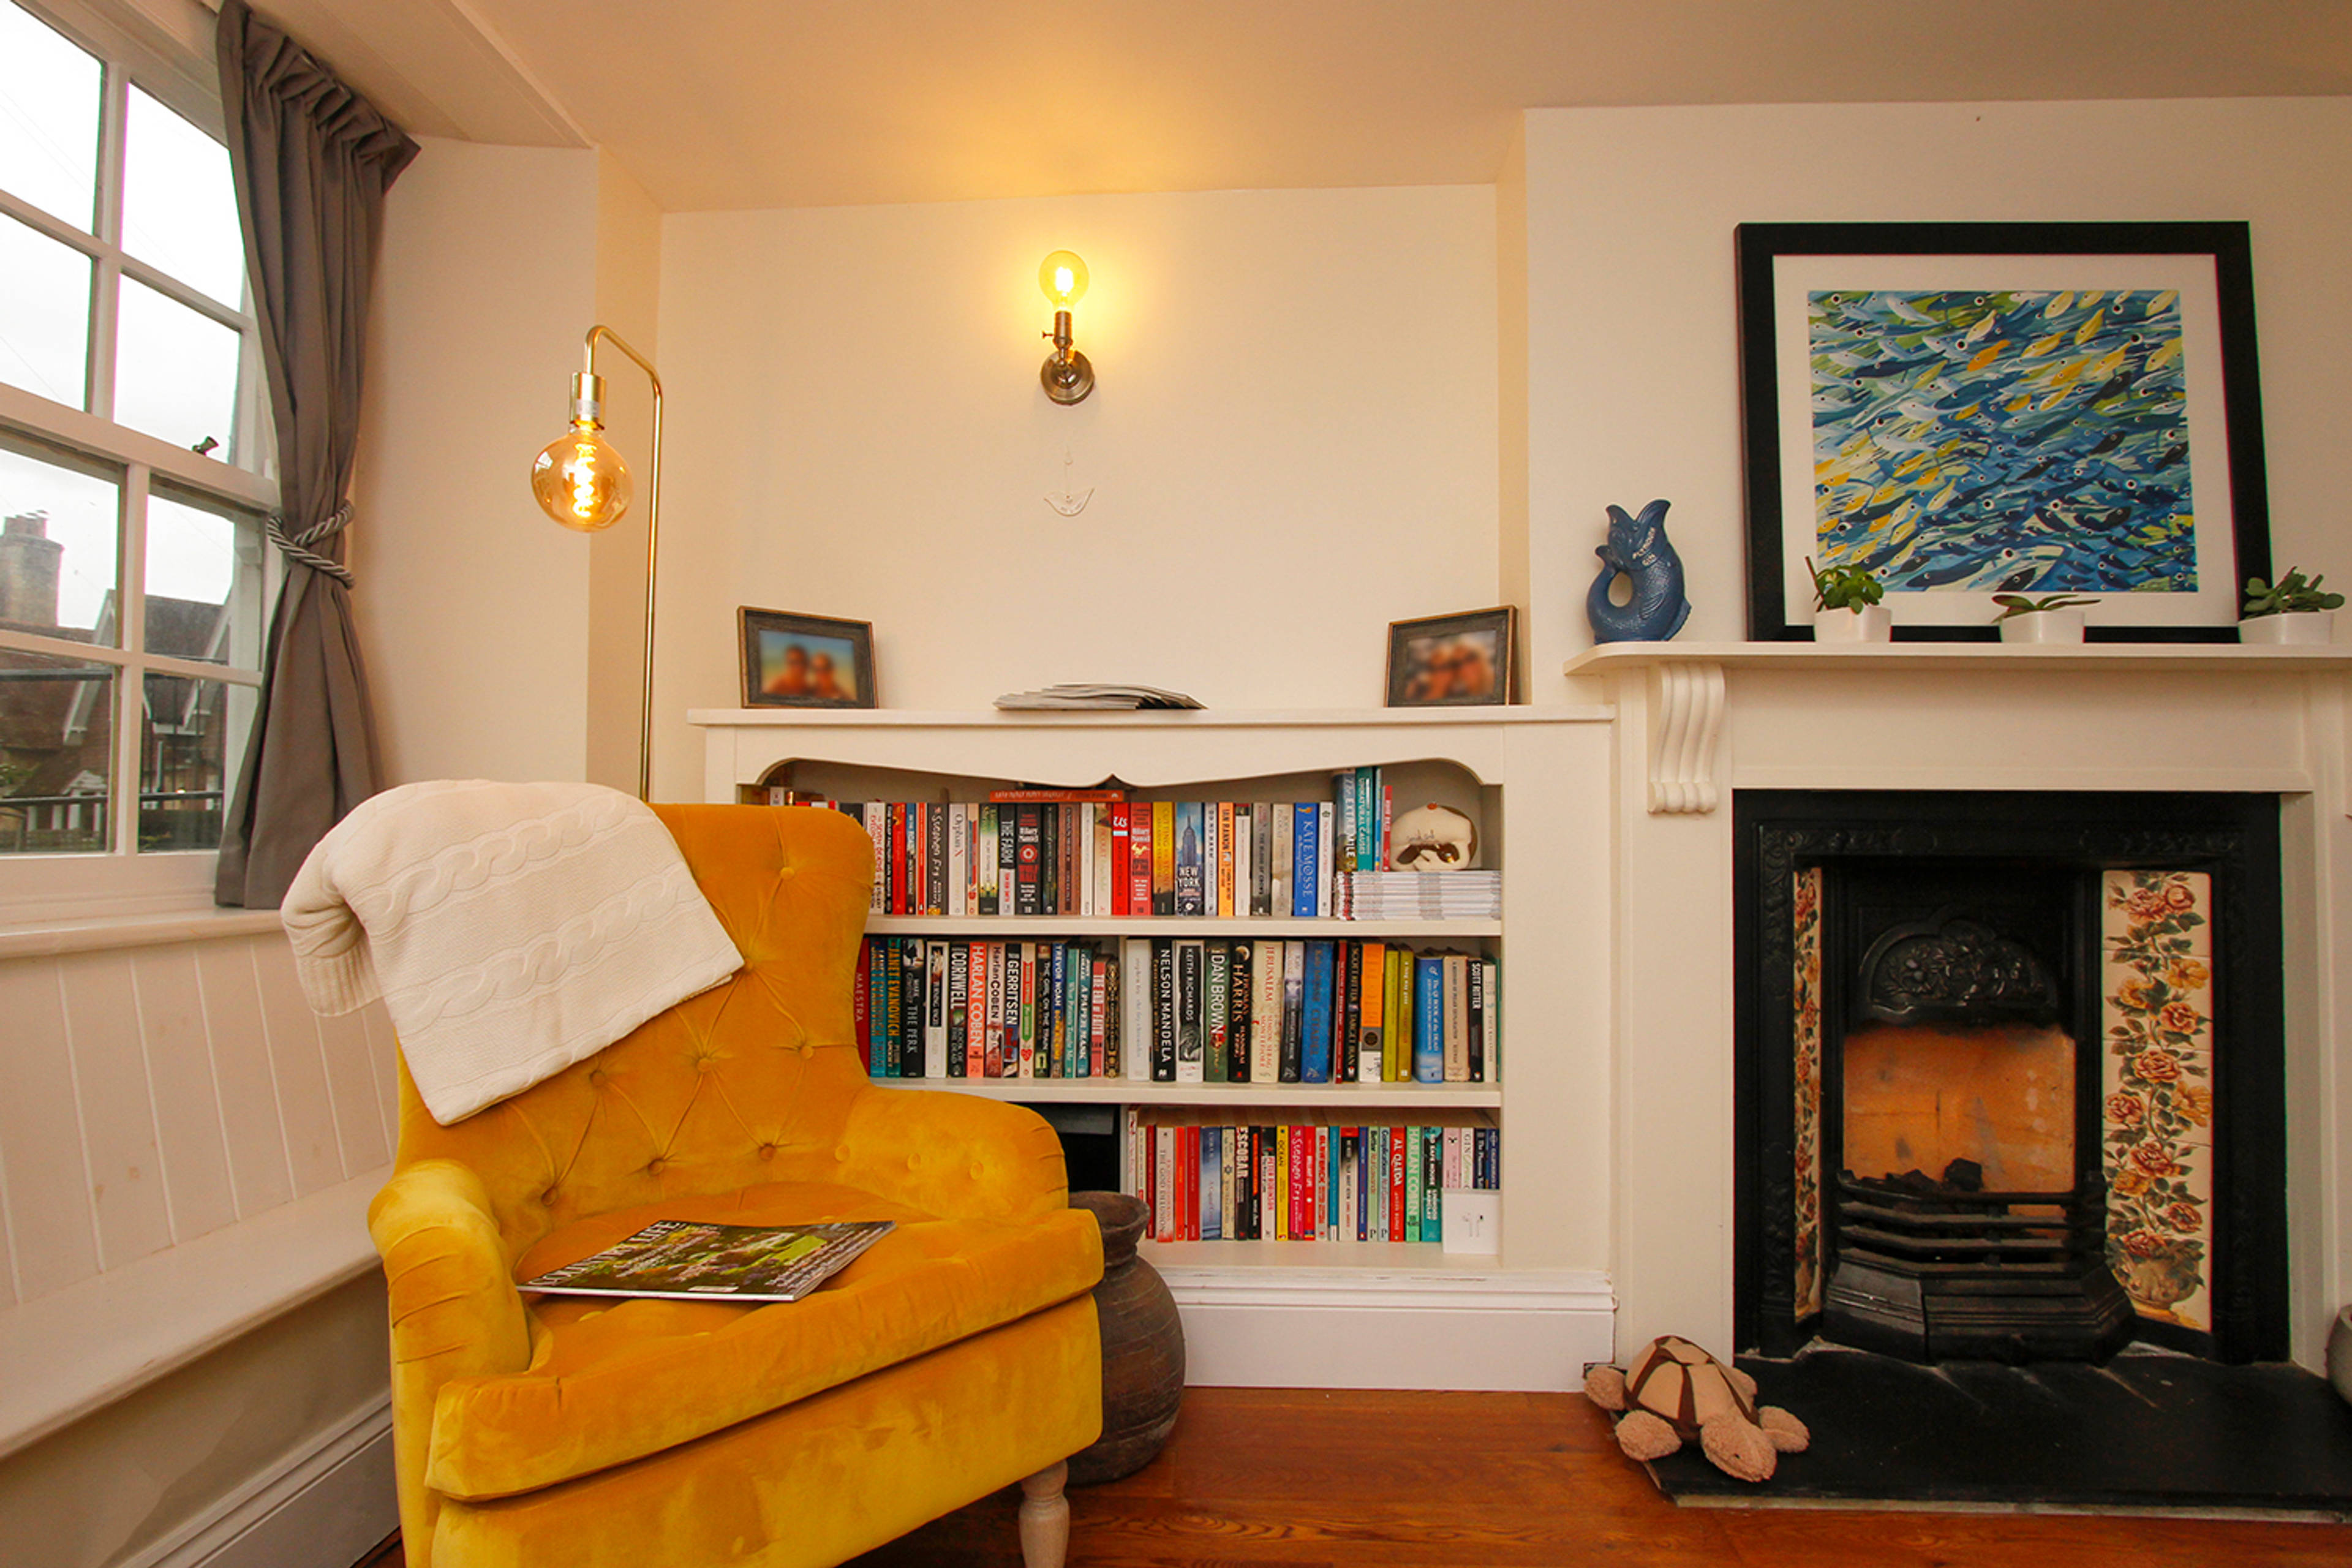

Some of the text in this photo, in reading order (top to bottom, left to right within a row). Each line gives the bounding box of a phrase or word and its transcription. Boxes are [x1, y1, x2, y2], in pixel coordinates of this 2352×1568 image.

[952, 813, 964, 848] Orphan
[1001, 820, 1014, 864] THE FARM
[1221, 823, 1230, 850] RANKIN
[932, 859, 941, 877] Fry
[1178, 866, 1199, 876] NEW
[1302, 821, 1314, 897] KATE MOSSE
[951, 953, 966, 1009] CORNWELL
[992, 946, 1001, 979] Harlan
[1210, 954, 1225, 982] DAN
[1265, 946, 1275, 1002] JERUSALEM
[1351, 948, 1360, 974] SCOTT
[871, 947, 884, 1036] JANET EVANOVICH
[888, 948, 900, 1036] JANET EVANOVICH
[970, 945, 984, 1047] HARLAN COBEN
[991, 979, 1001, 1019] COBEN
[1006, 960, 1019, 1025] GERRITSEN
[1043, 999, 1050, 1010] ON
[1093, 974, 1104, 1036] THE END FAITH
[1161, 949, 1172, 1063] NELSON MANDELA
[1210, 984, 1225, 1034] BROWN
[1232, 964, 1245, 1022] HARRIS
[1472, 962, 1482, 1009] SCOTT RITTER
[907, 1005, 918, 1053] THE PERK
[1310, 1009, 1320, 1056] CITADEL
[1348, 1013, 1358, 1065] TARGET IRAN
[1237, 1126, 1249, 1178] ESCOBAR
[1380, 1129, 1389, 1177] Complications
[1391, 1138, 1403, 1186] AL QAEDA
[1430, 1133, 1436, 1144] NO
[1291, 1137, 1303, 1200] Stephen Fry
[1408, 1129, 1419, 1215] HARLAN COBEN
[628, 1221, 680, 1243] LIFE
